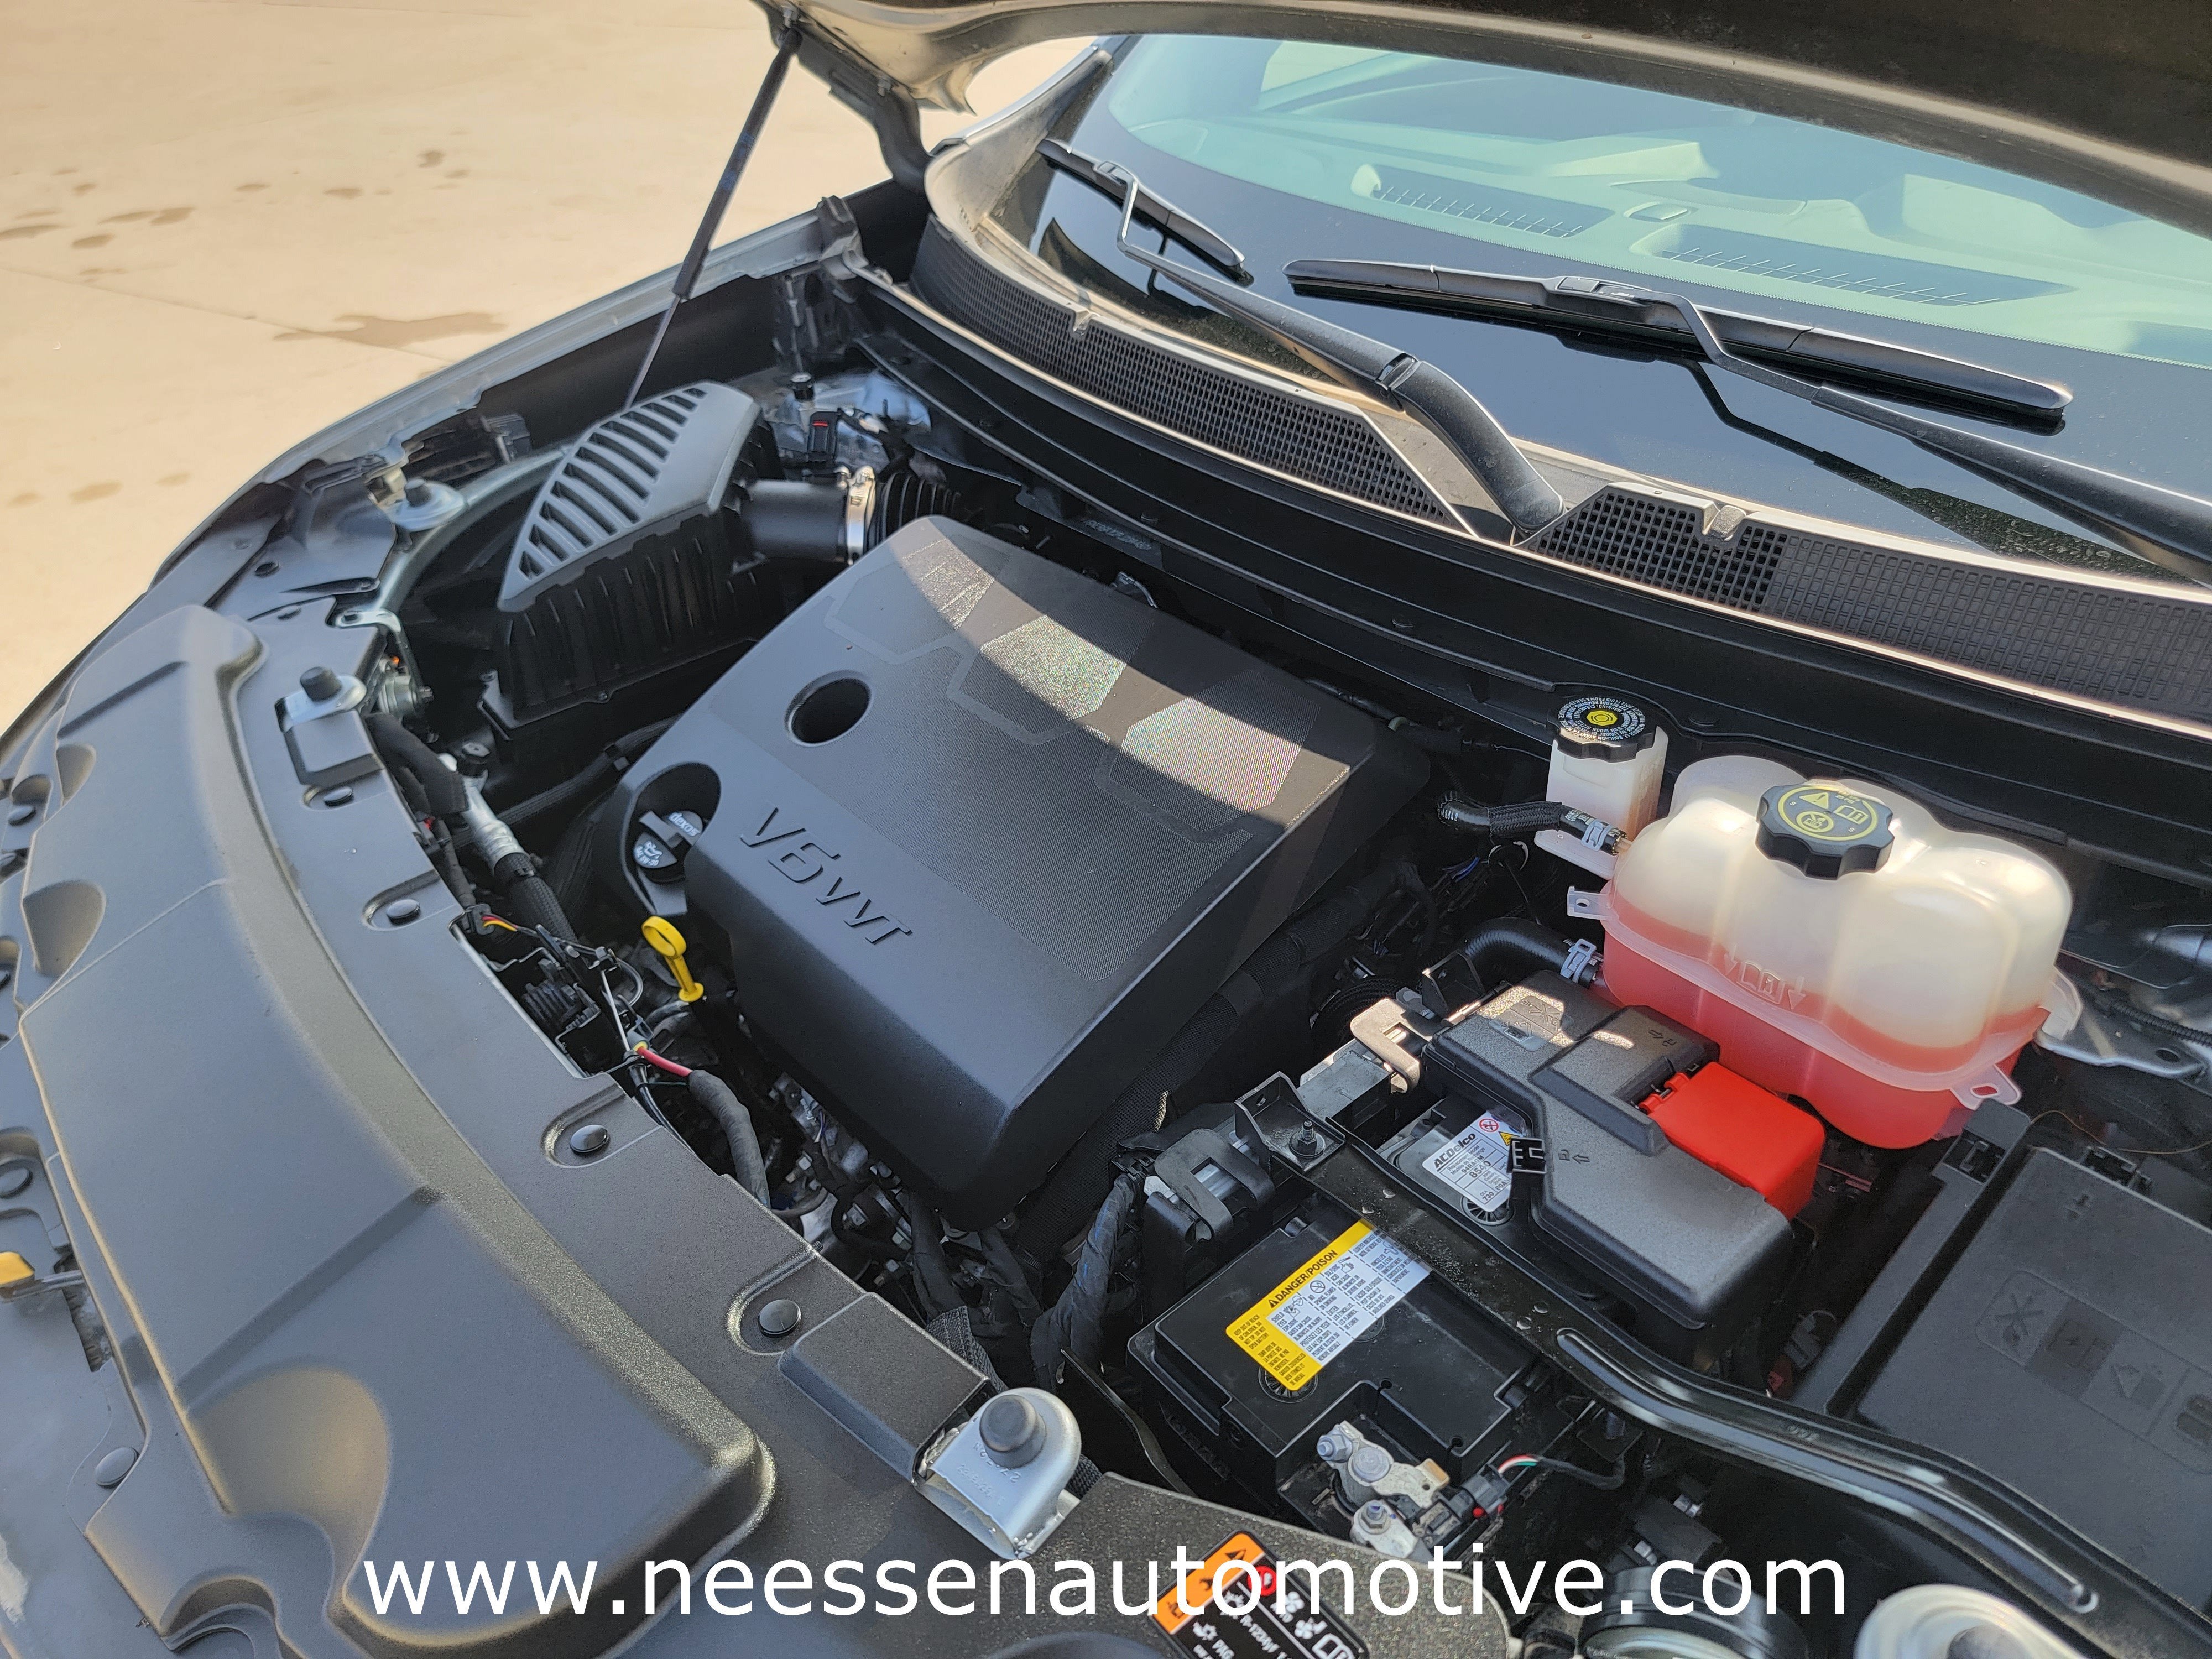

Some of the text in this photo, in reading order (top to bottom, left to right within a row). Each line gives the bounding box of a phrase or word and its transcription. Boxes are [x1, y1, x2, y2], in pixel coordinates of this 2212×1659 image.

[668, 812, 701, 837] dexos
[739, 803, 841, 884] V6
[1433, 1133, 1477, 1168] ACDelco
[1467, 1145, 1480, 1154] Model
[1469, 1161, 1491, 1178] 8540
[1483, 1192, 1494, 1201] 730
[1276, 1250, 1337, 1301] DANGER/POISON
[1323, 1264, 1340, 1277] SULFURIC
[1329, 1273, 1339, 1281] ACID
[1340, 1273, 1350, 1281] CAUSE
[1323, 1295, 1337, 1307] SMOKING
[1270, 1311, 1285, 1323] SHIELD
[1276, 1318, 1287, 1328] EYES
[1301, 1315, 1312, 1325] CAUSE
[1313, 1326, 1323, 1335] LES
[1318, 1319, 1331, 1330] YEUX
